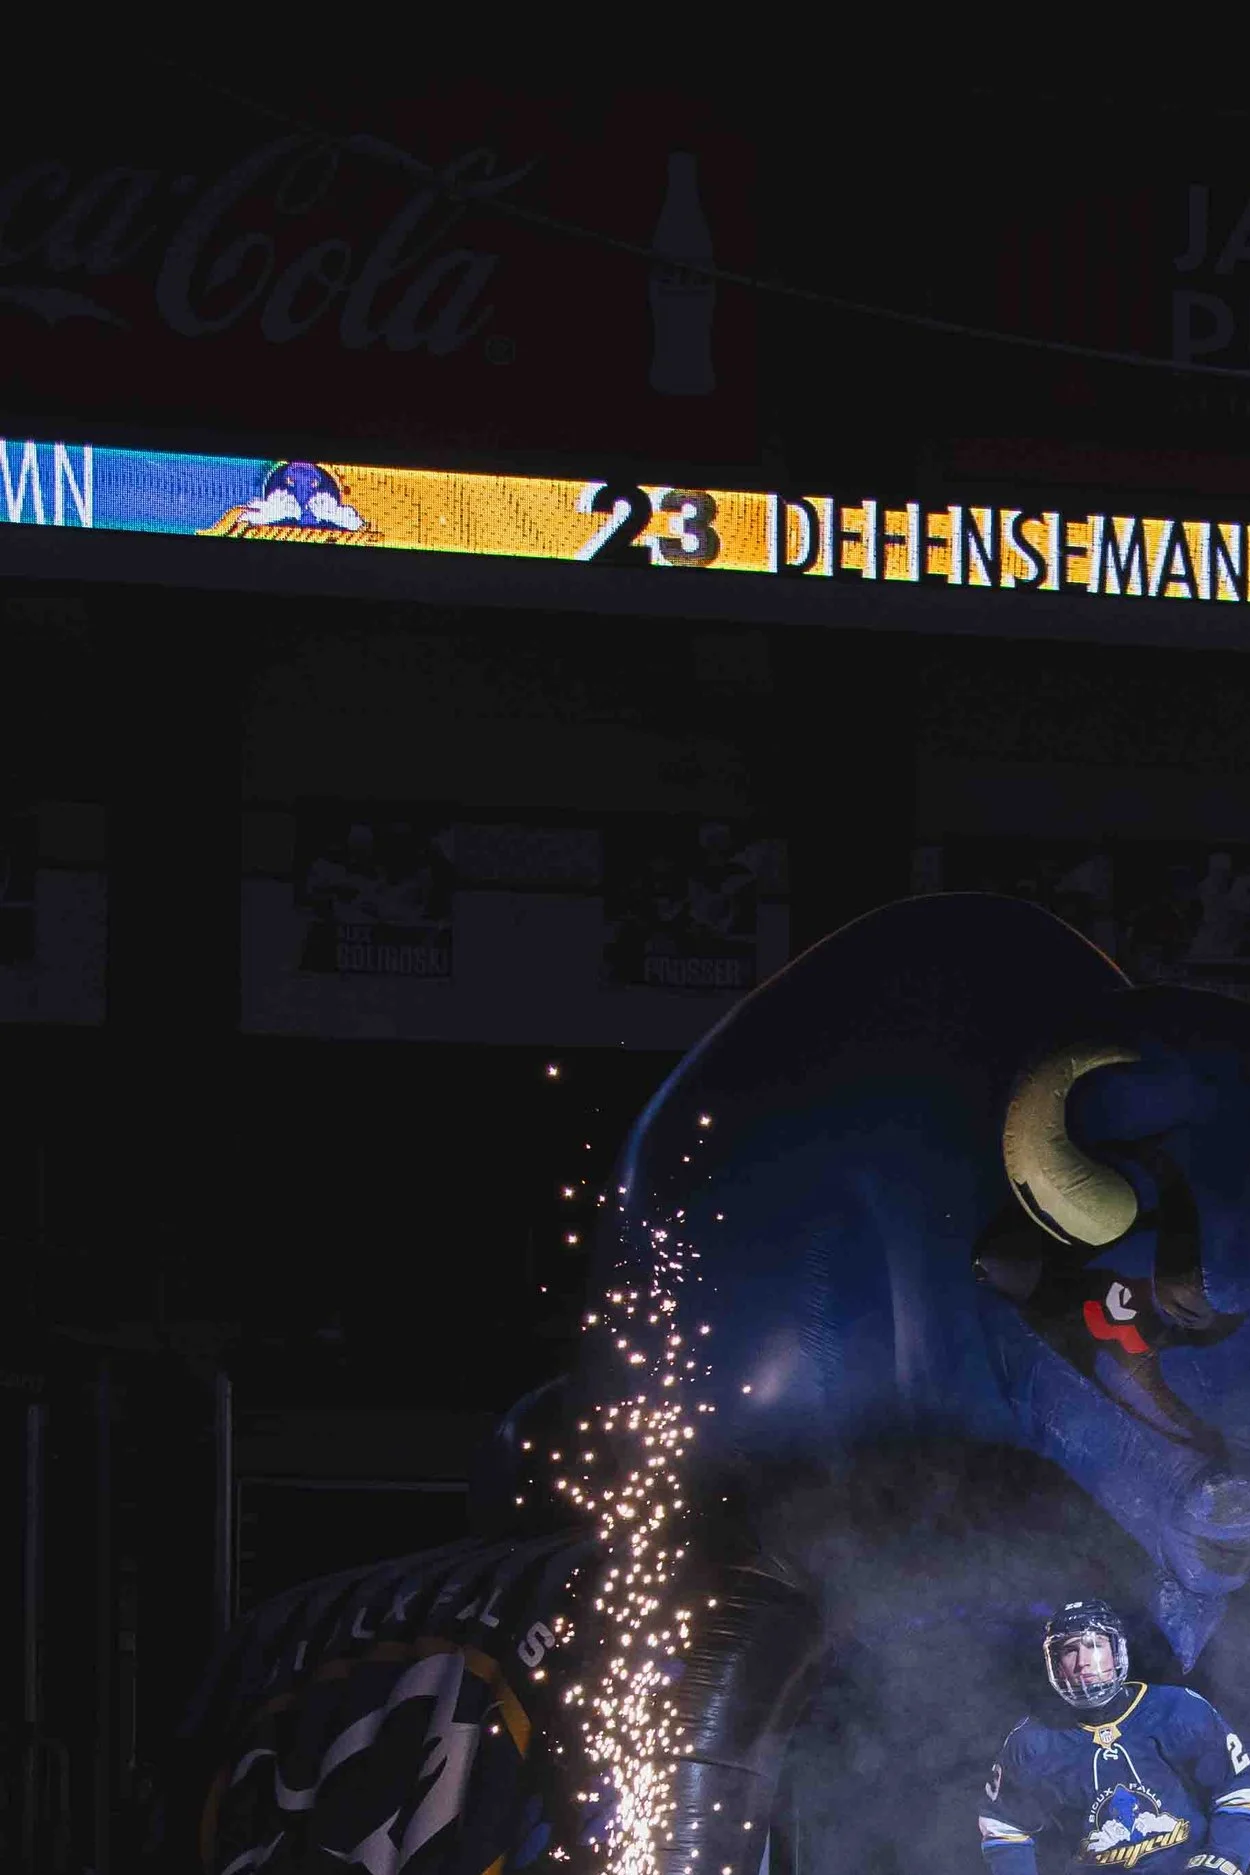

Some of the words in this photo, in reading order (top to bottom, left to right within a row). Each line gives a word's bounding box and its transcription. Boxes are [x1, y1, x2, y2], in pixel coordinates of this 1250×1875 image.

[588, 480, 721, 568] 23
[776, 487, 1248, 604] DEFENSEMAN
[1088, 1786, 1114, 1823] SIOUX
[1128, 1782, 1163, 1809] FALLS
